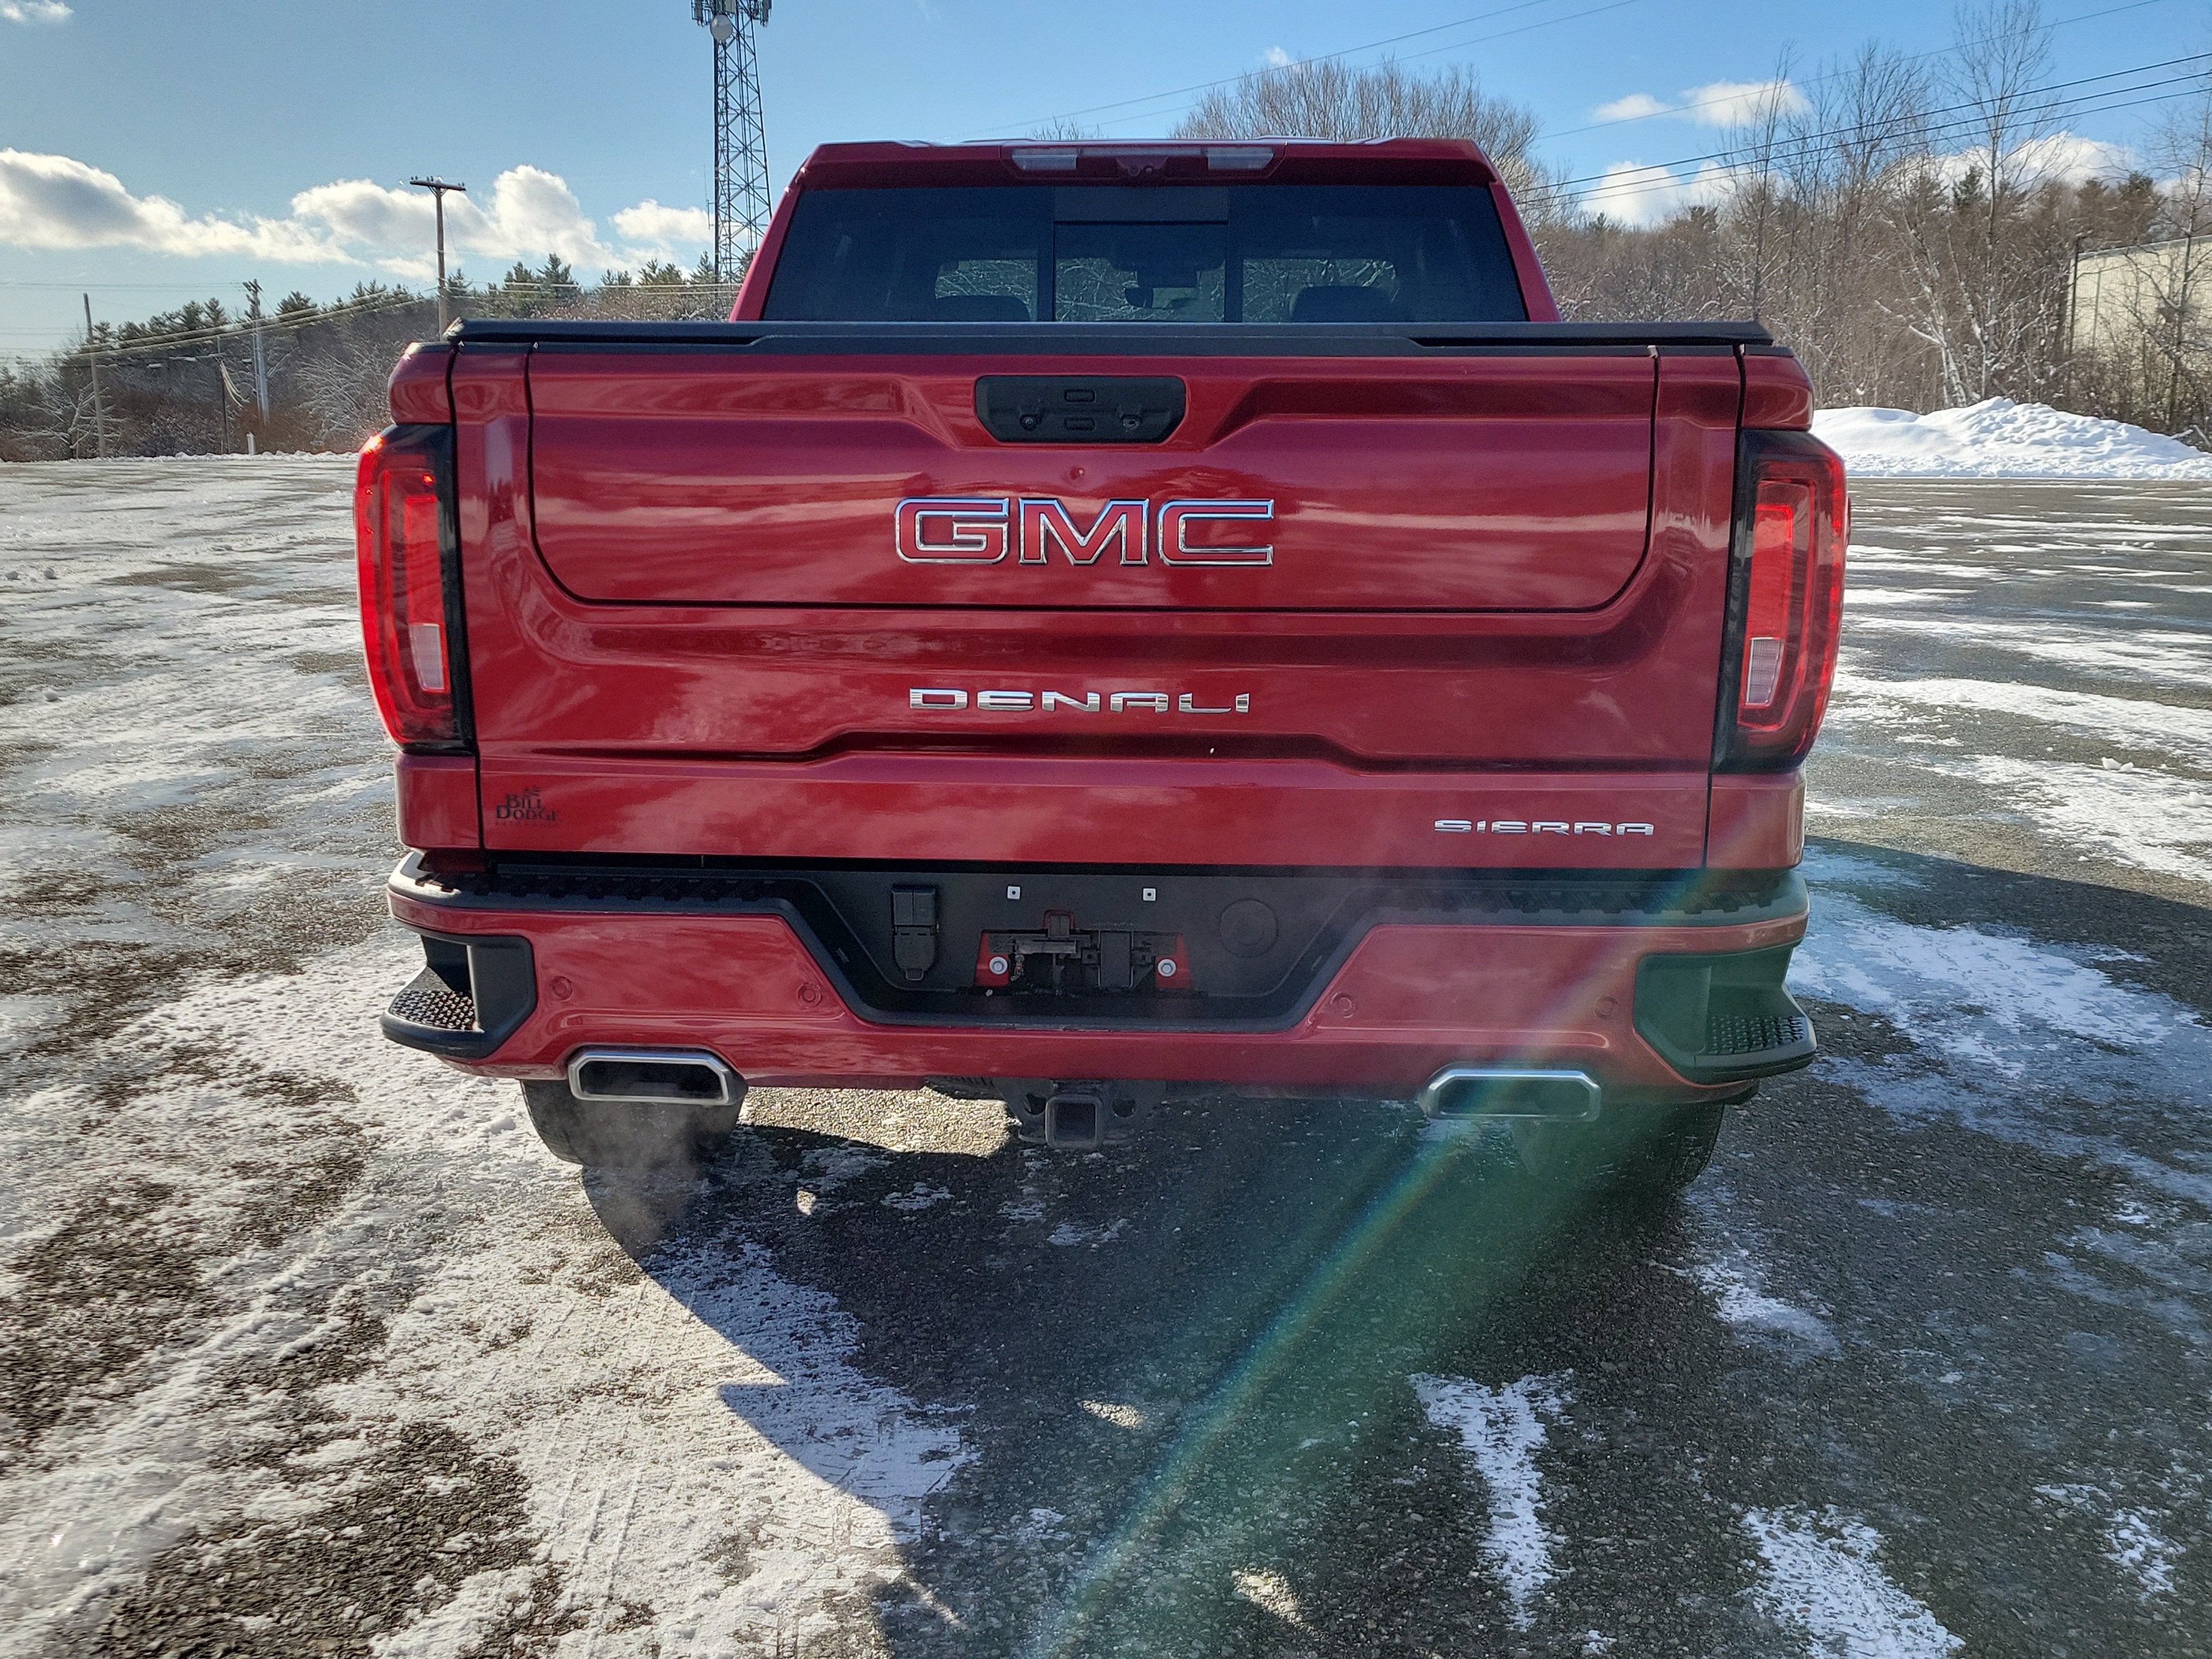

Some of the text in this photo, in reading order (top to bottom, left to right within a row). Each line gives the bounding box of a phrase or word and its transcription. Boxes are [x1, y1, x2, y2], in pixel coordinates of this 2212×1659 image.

[895, 497, 1274, 566] GMC
[910, 687, 1250, 714] DENALI
[1434, 819, 1655, 837] SIERRA
